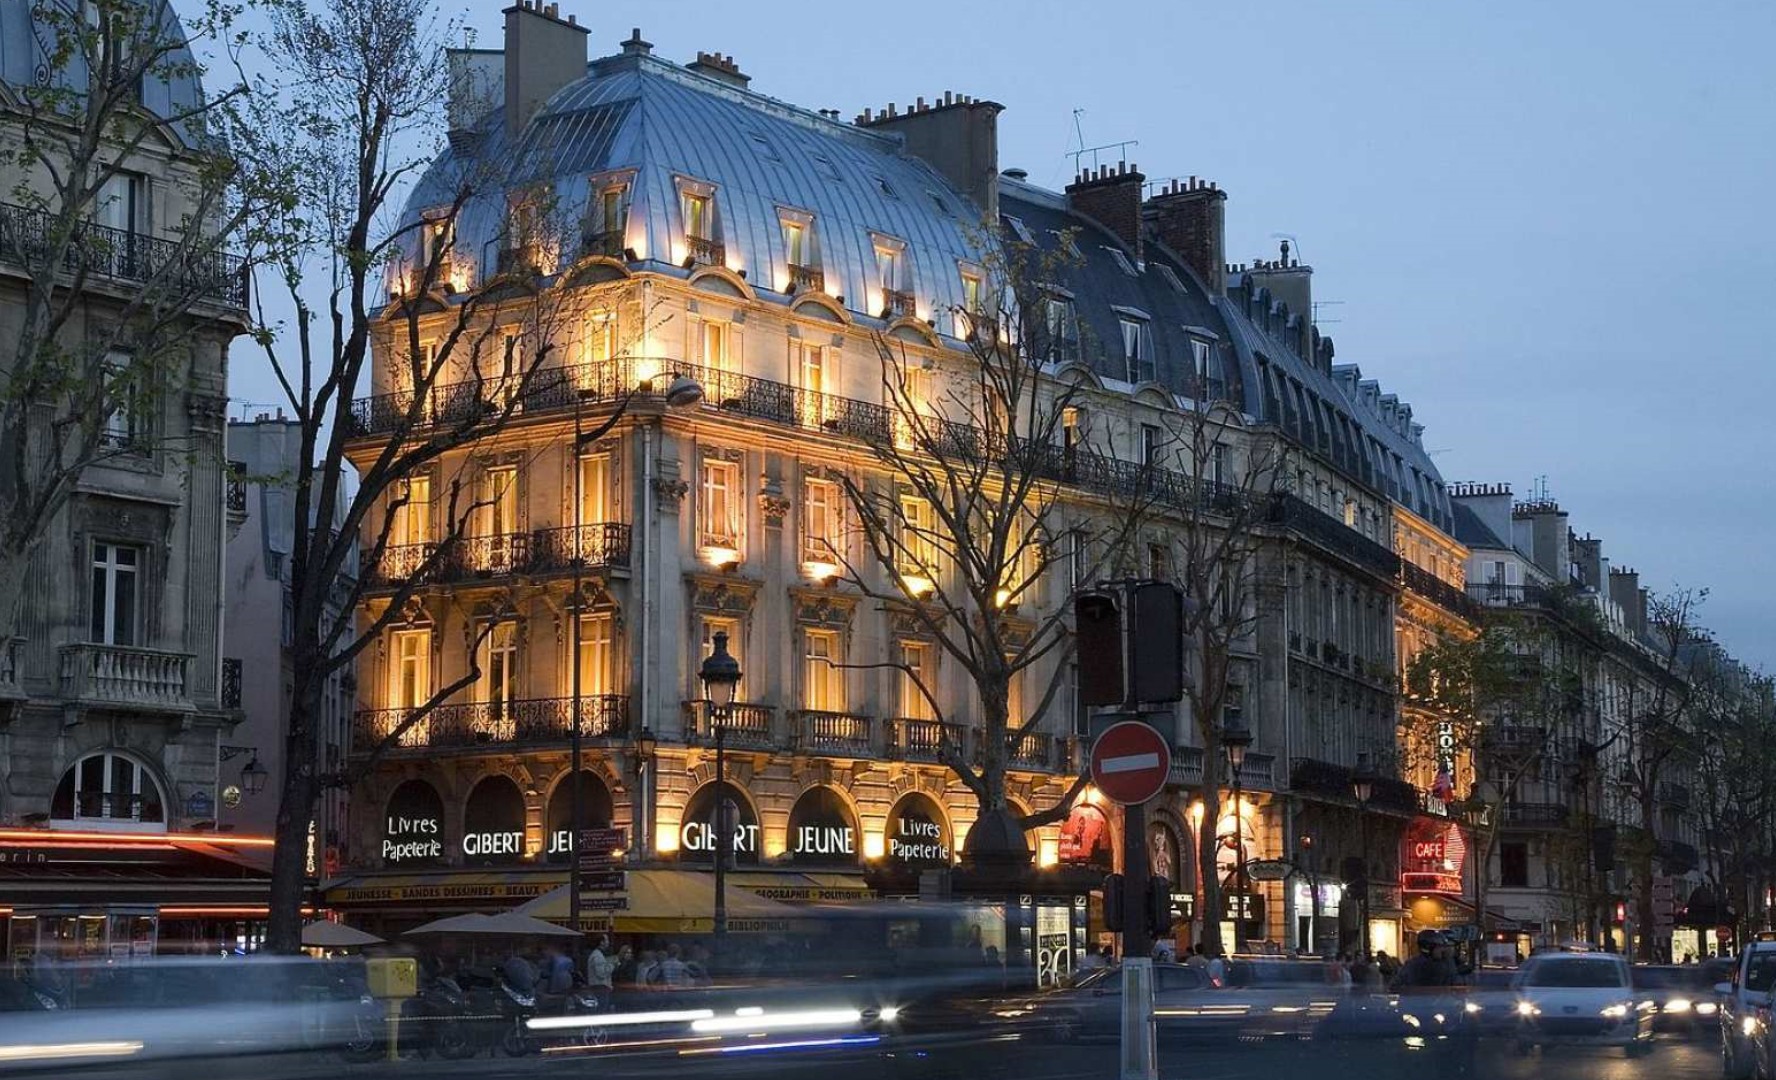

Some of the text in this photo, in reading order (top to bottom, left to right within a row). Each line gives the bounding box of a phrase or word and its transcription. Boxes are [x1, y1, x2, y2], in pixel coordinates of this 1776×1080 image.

[388, 816, 438, 834] Livres
[900, 817, 941, 838] Livres
[463, 832, 523, 855] GIBERT
[682, 822, 855, 854] GIBRT JEUNE
[382, 839, 441, 862] Papeterie
[888, 838, 950, 862] Papeterie
[346, 889, 391, 899] JEUNESSE
[402, 887, 440, 898] BANDES
[506, 885, 539, 896] BEAUX
